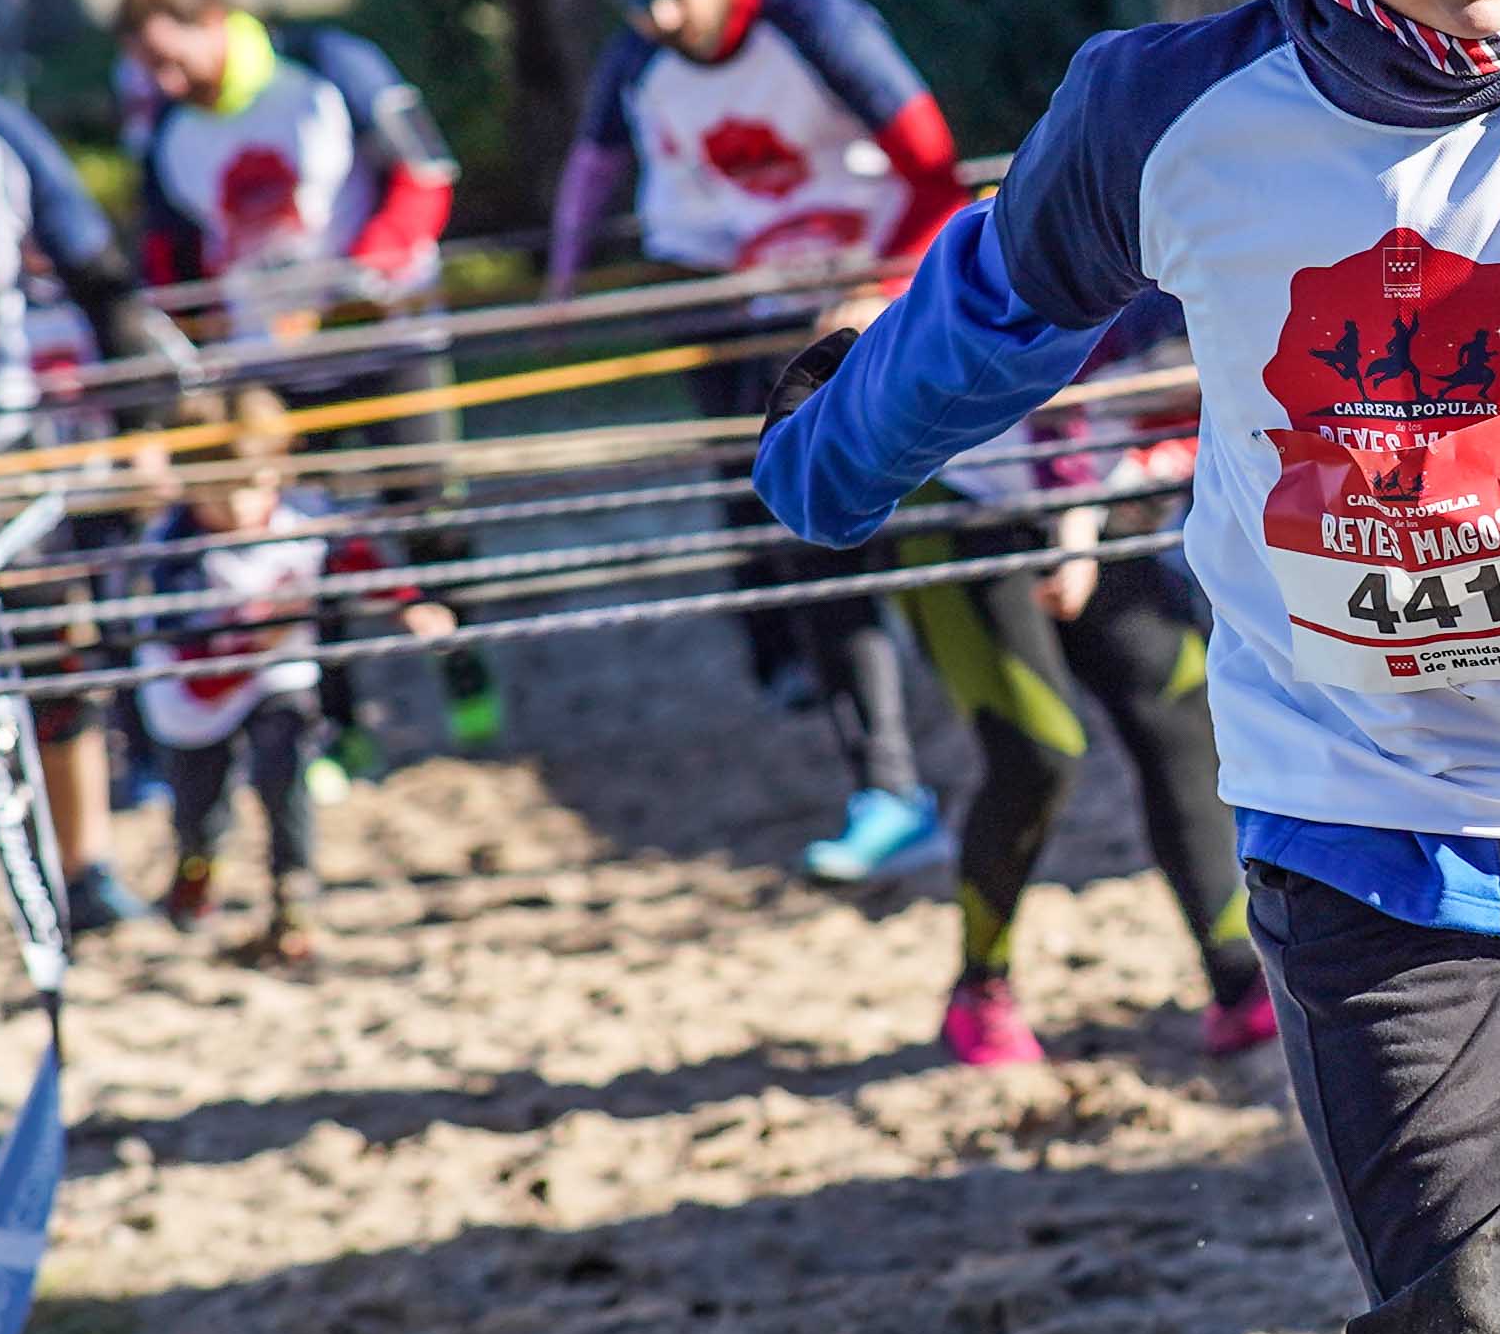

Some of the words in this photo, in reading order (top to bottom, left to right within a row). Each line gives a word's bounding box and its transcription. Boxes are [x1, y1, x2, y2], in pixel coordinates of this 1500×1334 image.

[1333, 402, 1407, 418] CARRERA
[1411, 402, 1498, 417] POPULAR
[1395, 422, 1406, 432] de
[1405, 494, 1481, 518] POPULAR
[1321, 512, 1404, 562] REYES
[1424, 659, 1447, 673] de
